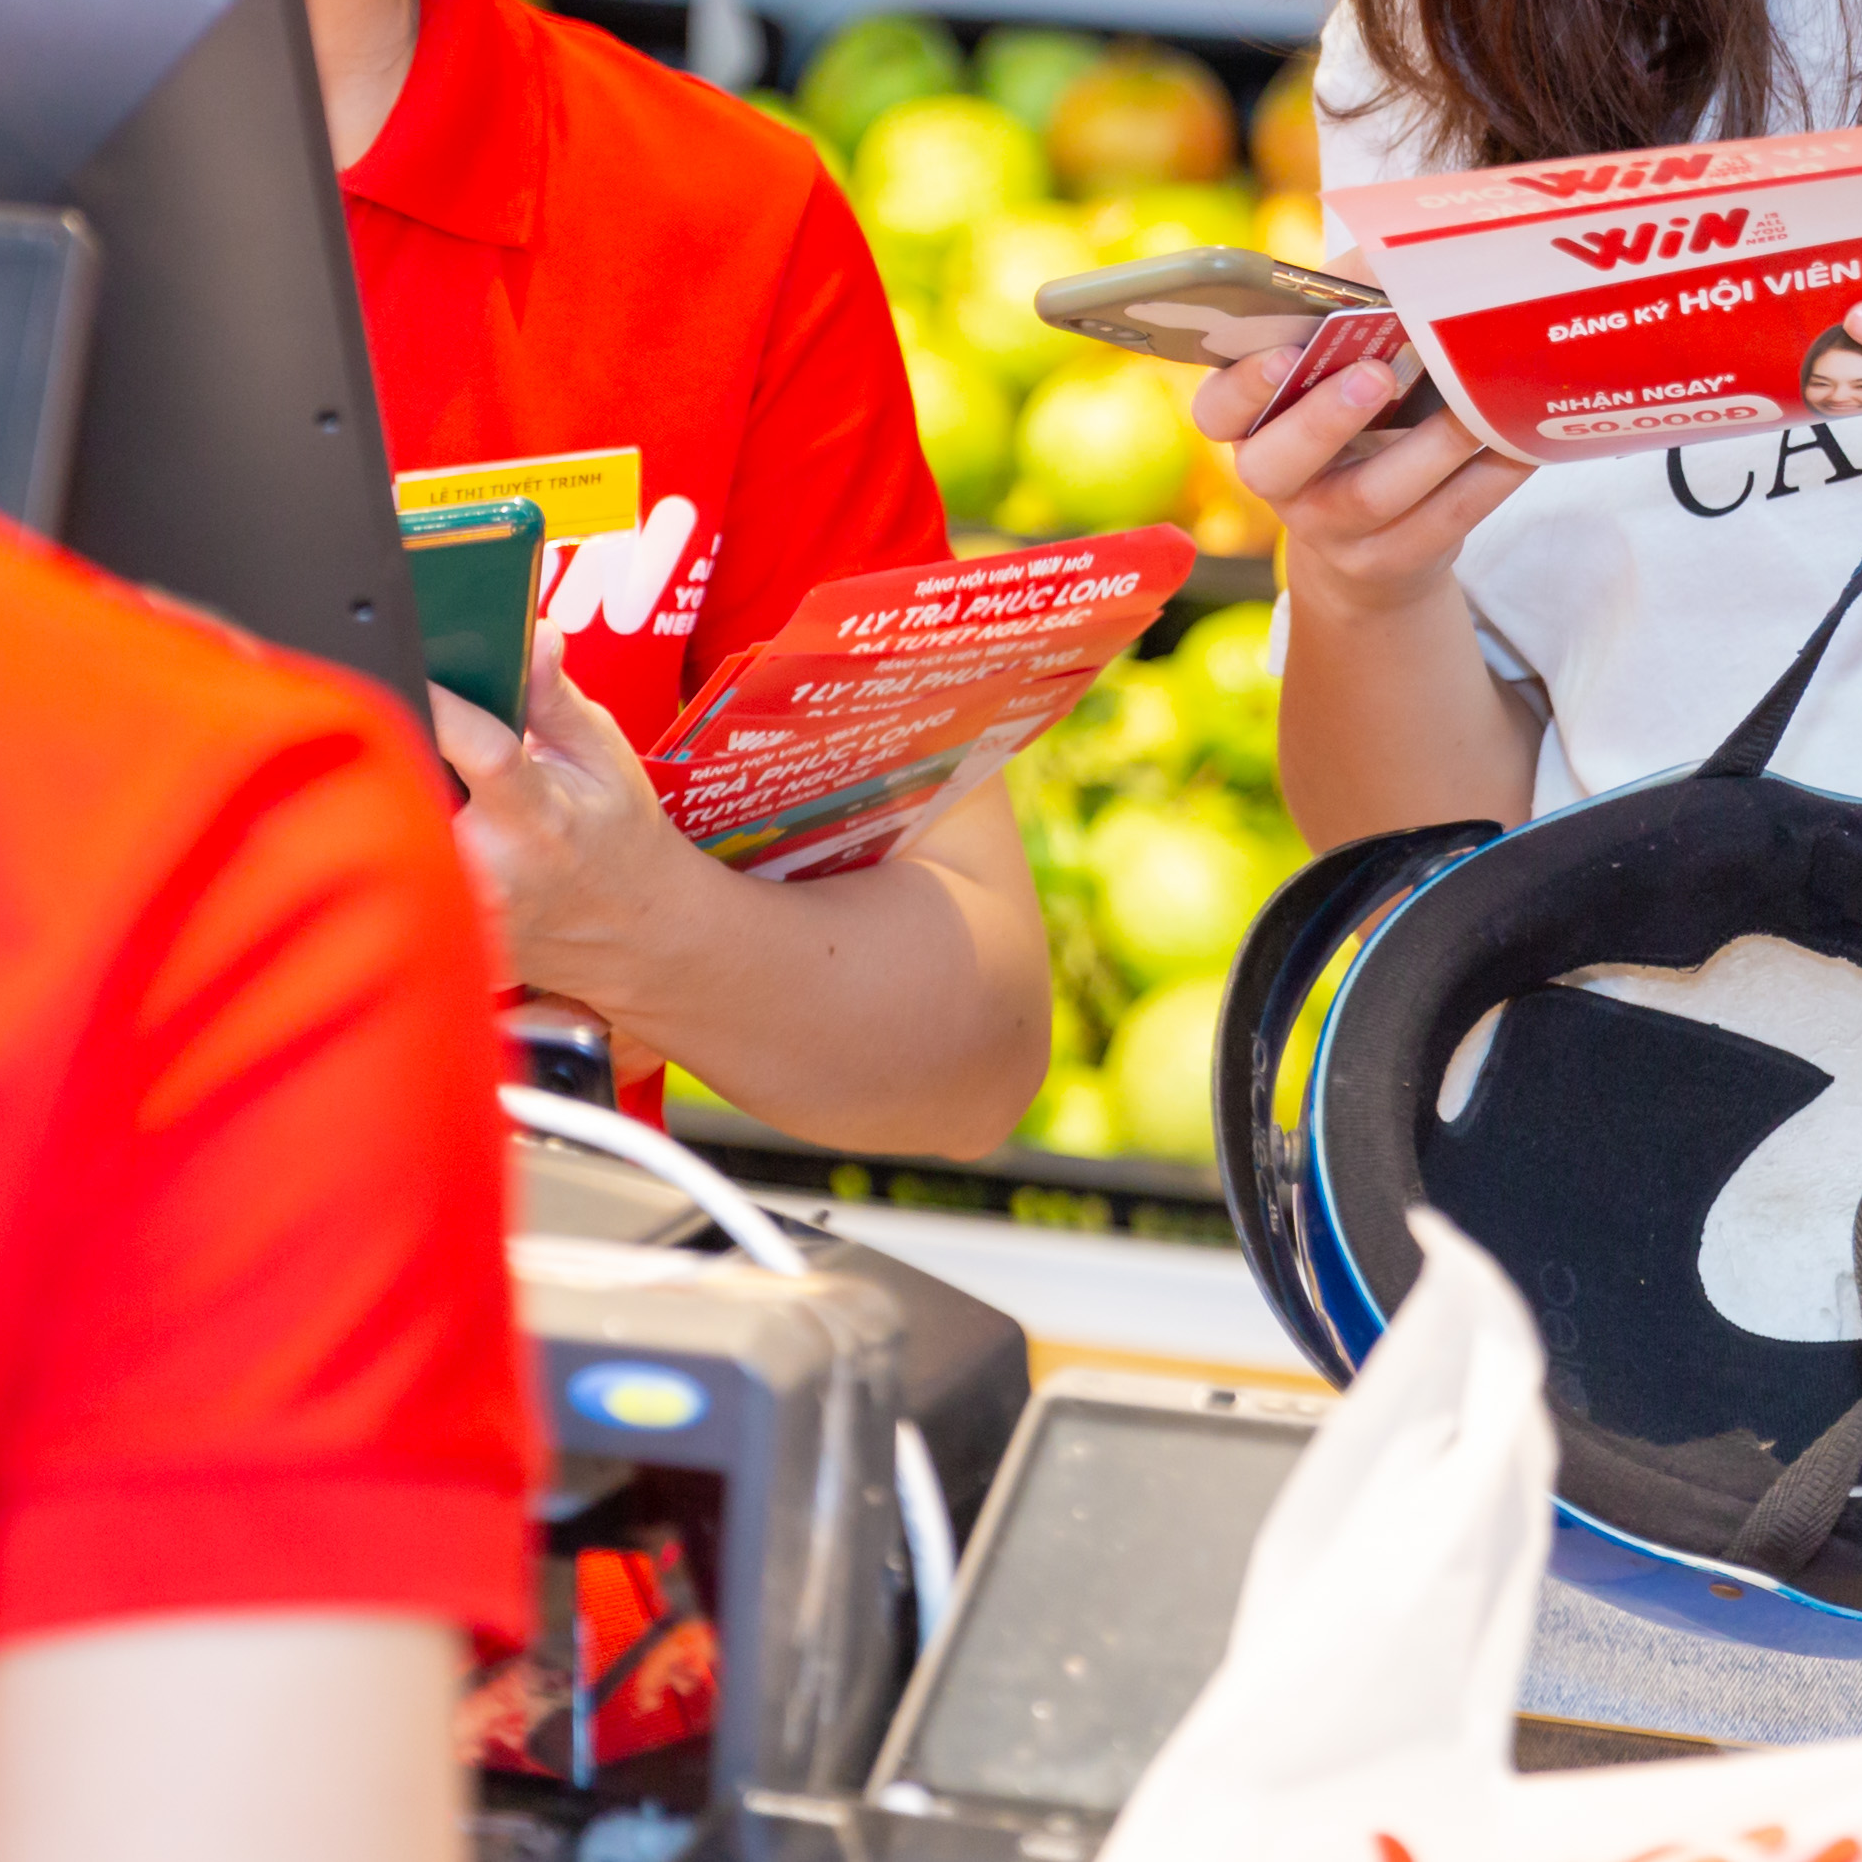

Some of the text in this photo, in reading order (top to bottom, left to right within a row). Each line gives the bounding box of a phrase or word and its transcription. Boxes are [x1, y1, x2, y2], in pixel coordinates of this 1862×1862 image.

[1751, 226, 1787, 237] YOU
[1755, 219, 1784, 229] ALL
[1551, 207, 1751, 272] WiN
[1745, 233, 1789, 246] NEED
[1546, 258, 1862, 344] ĐĂNG KÝ HỘI VIÊN
[1546, 387, 1636, 415] NHẬN
[837, 571, 1140, 638] 1 LY TRÀ PHÚC LONG
[809, 681, 855, 702] LY
[859, 707, 957, 753] LONG
